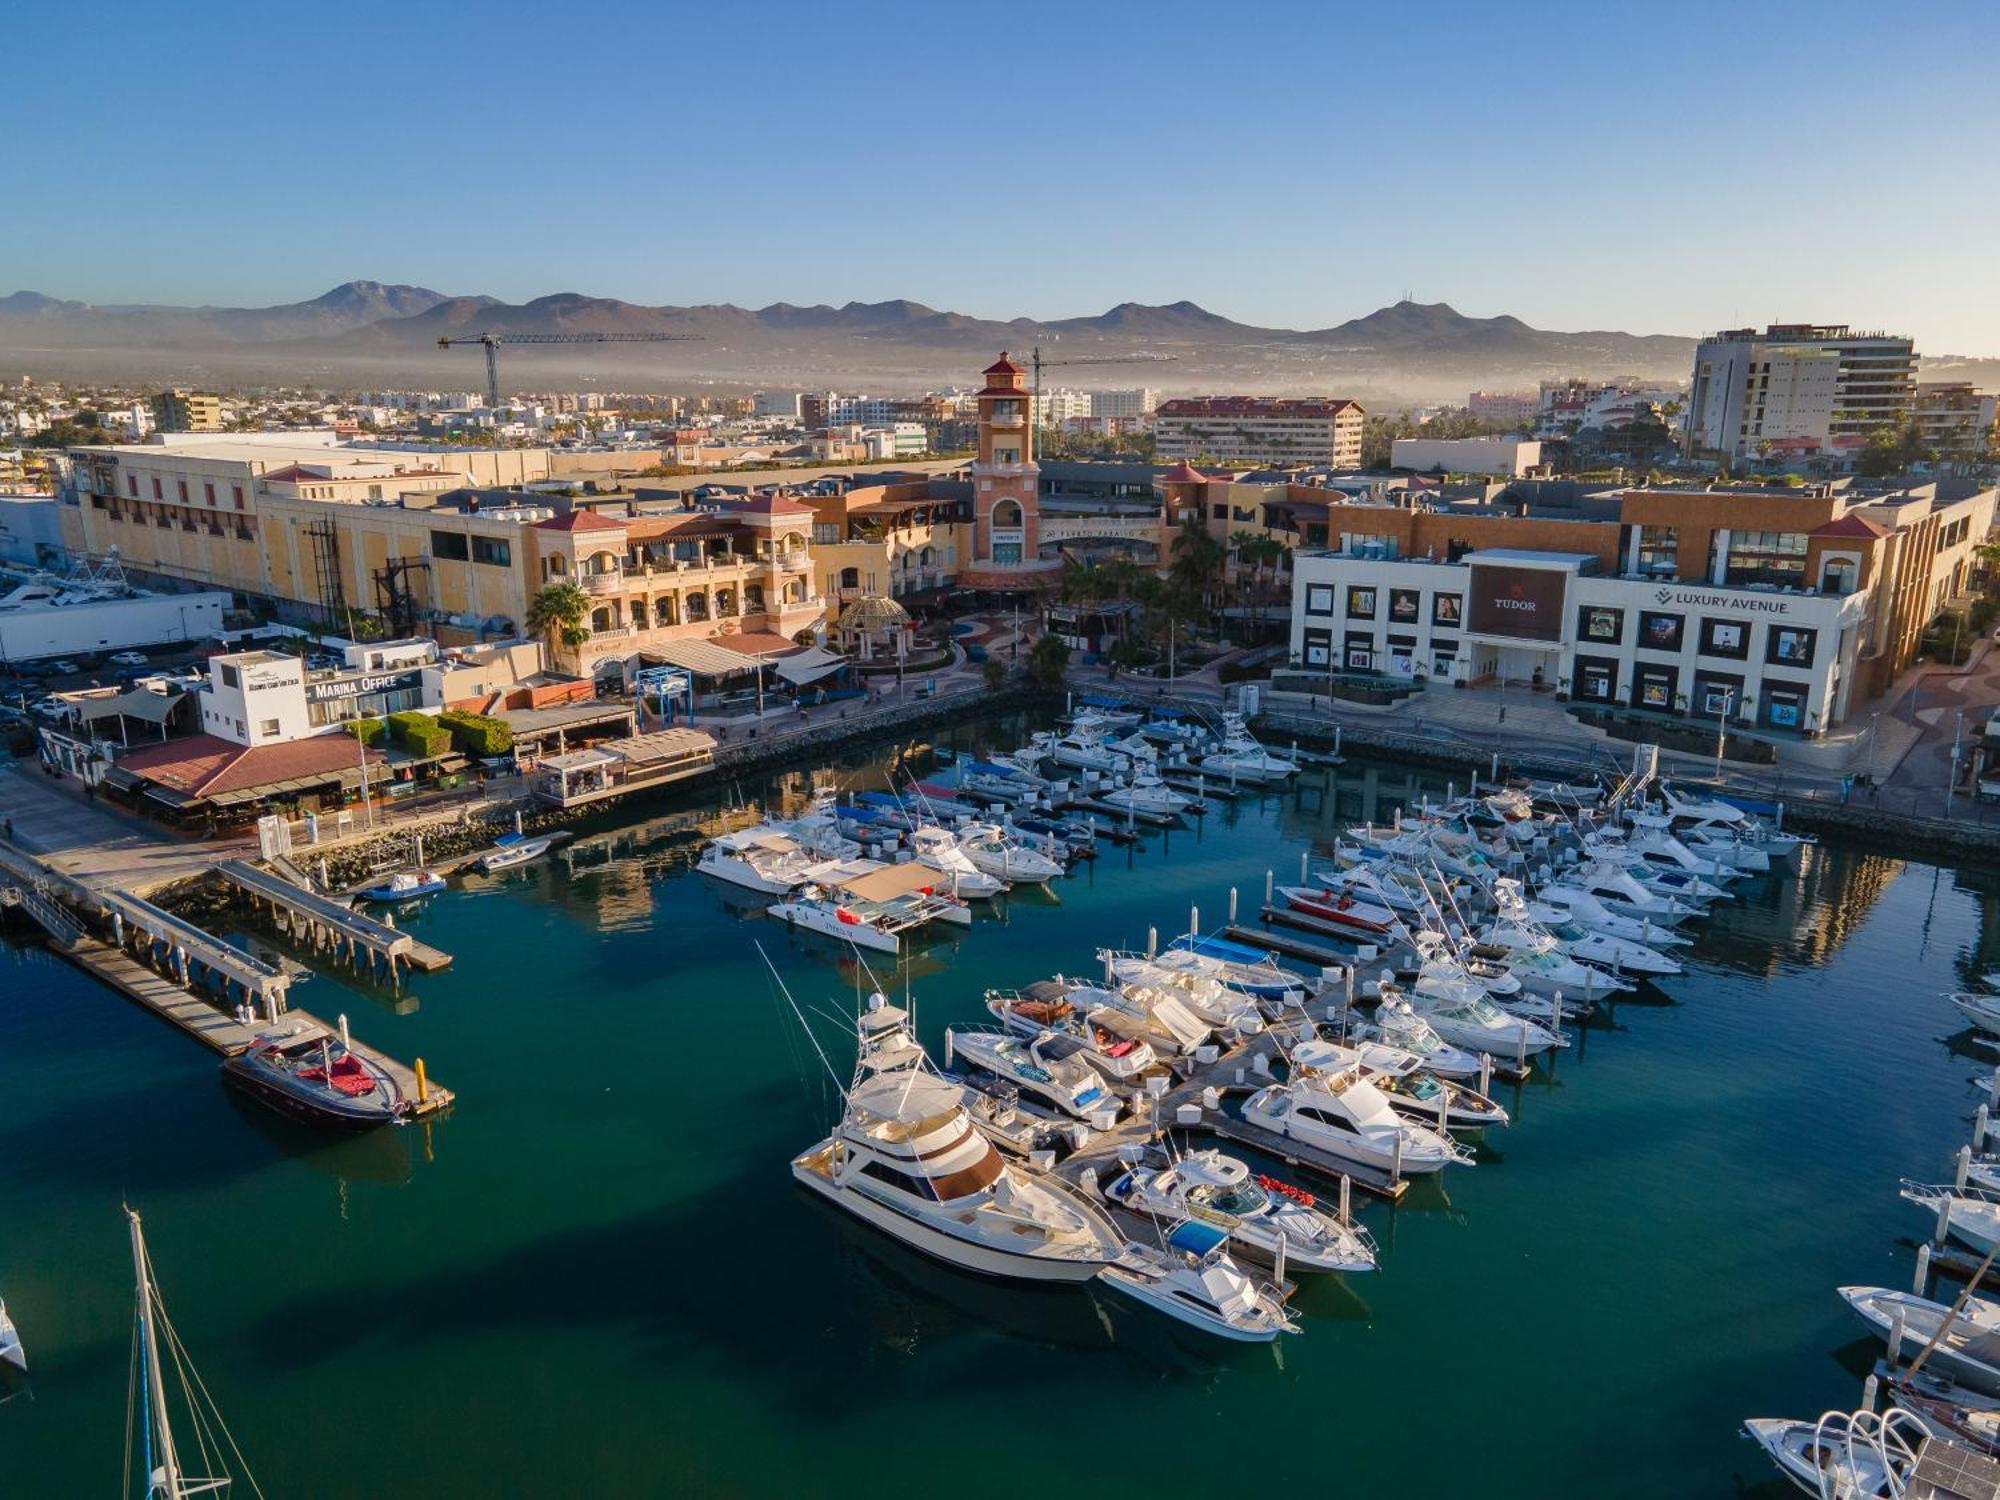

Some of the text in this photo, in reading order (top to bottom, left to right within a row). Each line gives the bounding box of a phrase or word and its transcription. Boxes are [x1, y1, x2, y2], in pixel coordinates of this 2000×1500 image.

[1494, 599, 1536, 611] TUDOR
[1676, 593, 1787, 614] LUXURY AVENUE
[315, 682, 358, 698] MARINA
[361, 675, 397, 691] OFFICE
